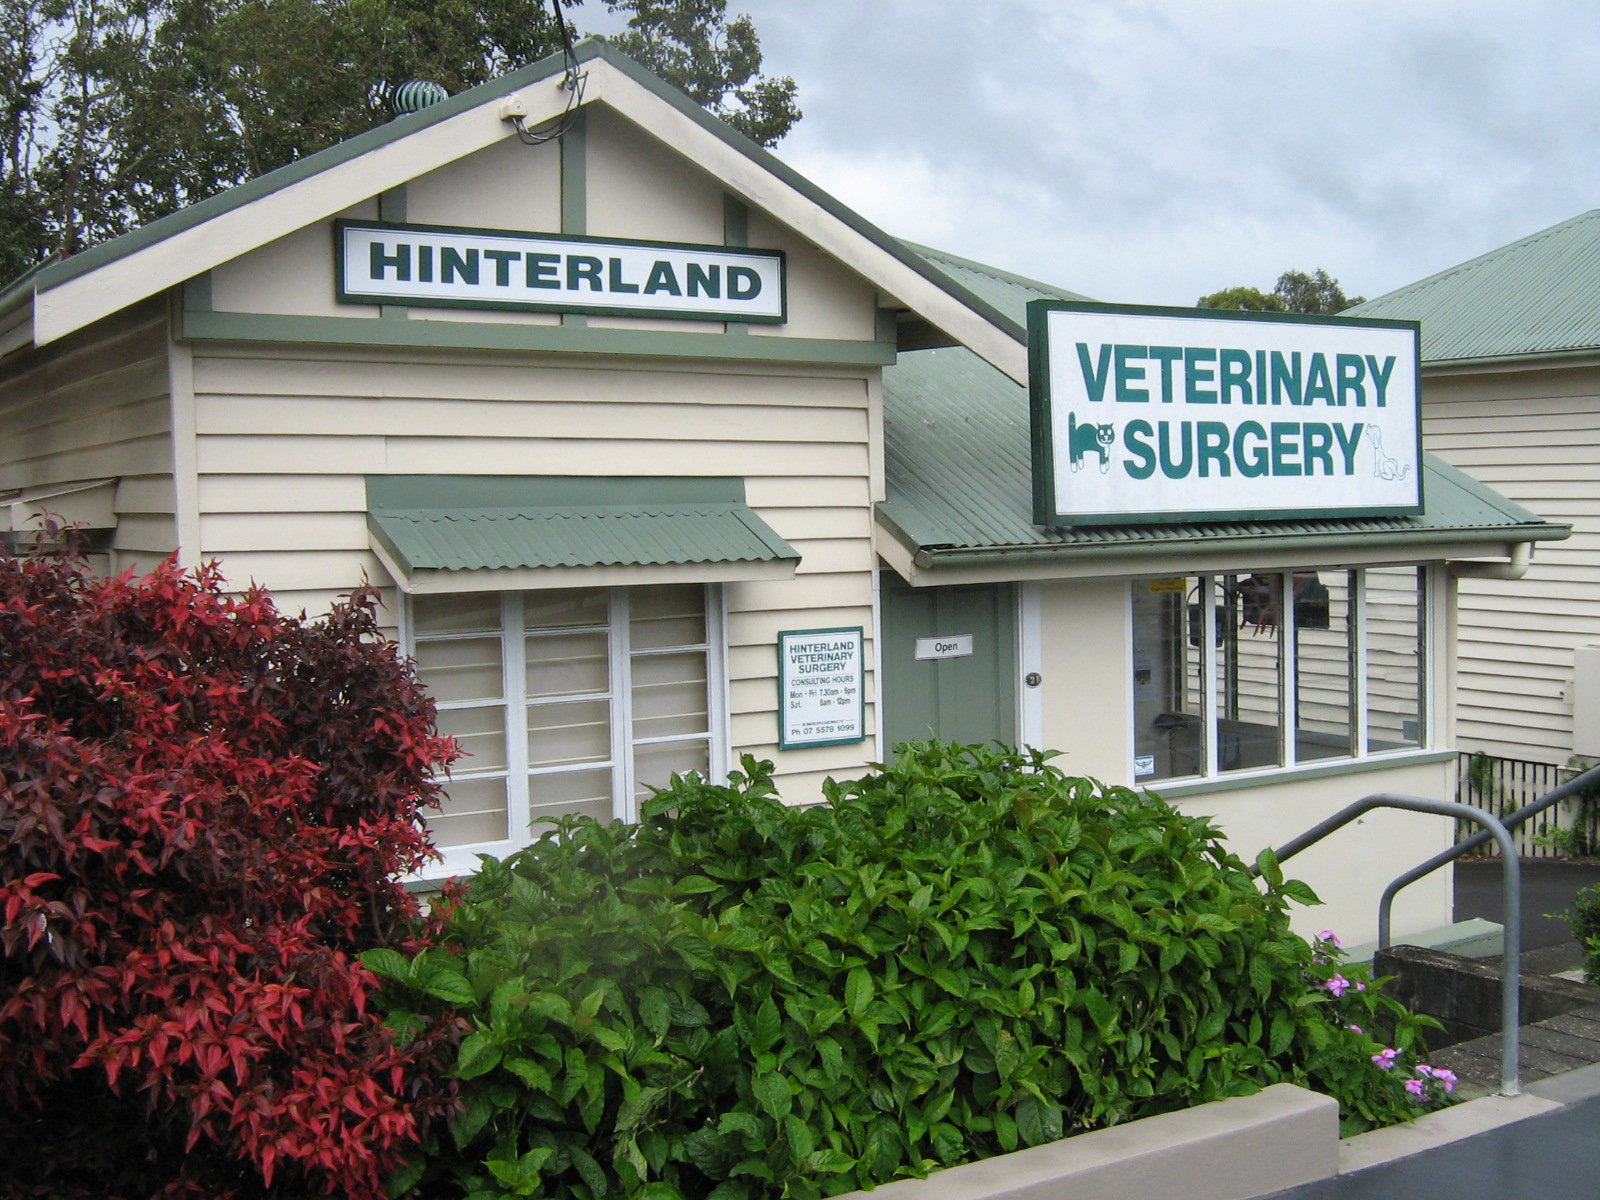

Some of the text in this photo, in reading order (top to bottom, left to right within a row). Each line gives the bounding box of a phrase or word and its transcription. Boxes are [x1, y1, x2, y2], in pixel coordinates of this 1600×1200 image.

[369, 242, 762, 300] HINTERLAND
[1075, 342, 1397, 407] VETERINARY
[1123, 418, 1364, 480] SURGERY
[790, 641, 854, 653] HINTERLAND
[934, 642, 958, 653] Open
[791, 652, 853, 663] VETERINARY
[799, 662, 846, 673] SURGERY
[791, 675, 854, 686] CONSULTING HOURS
[809, 689, 818, 697] Fri
[816, 725, 834, 734] 5578
[837, 724, 854, 732] 1099
